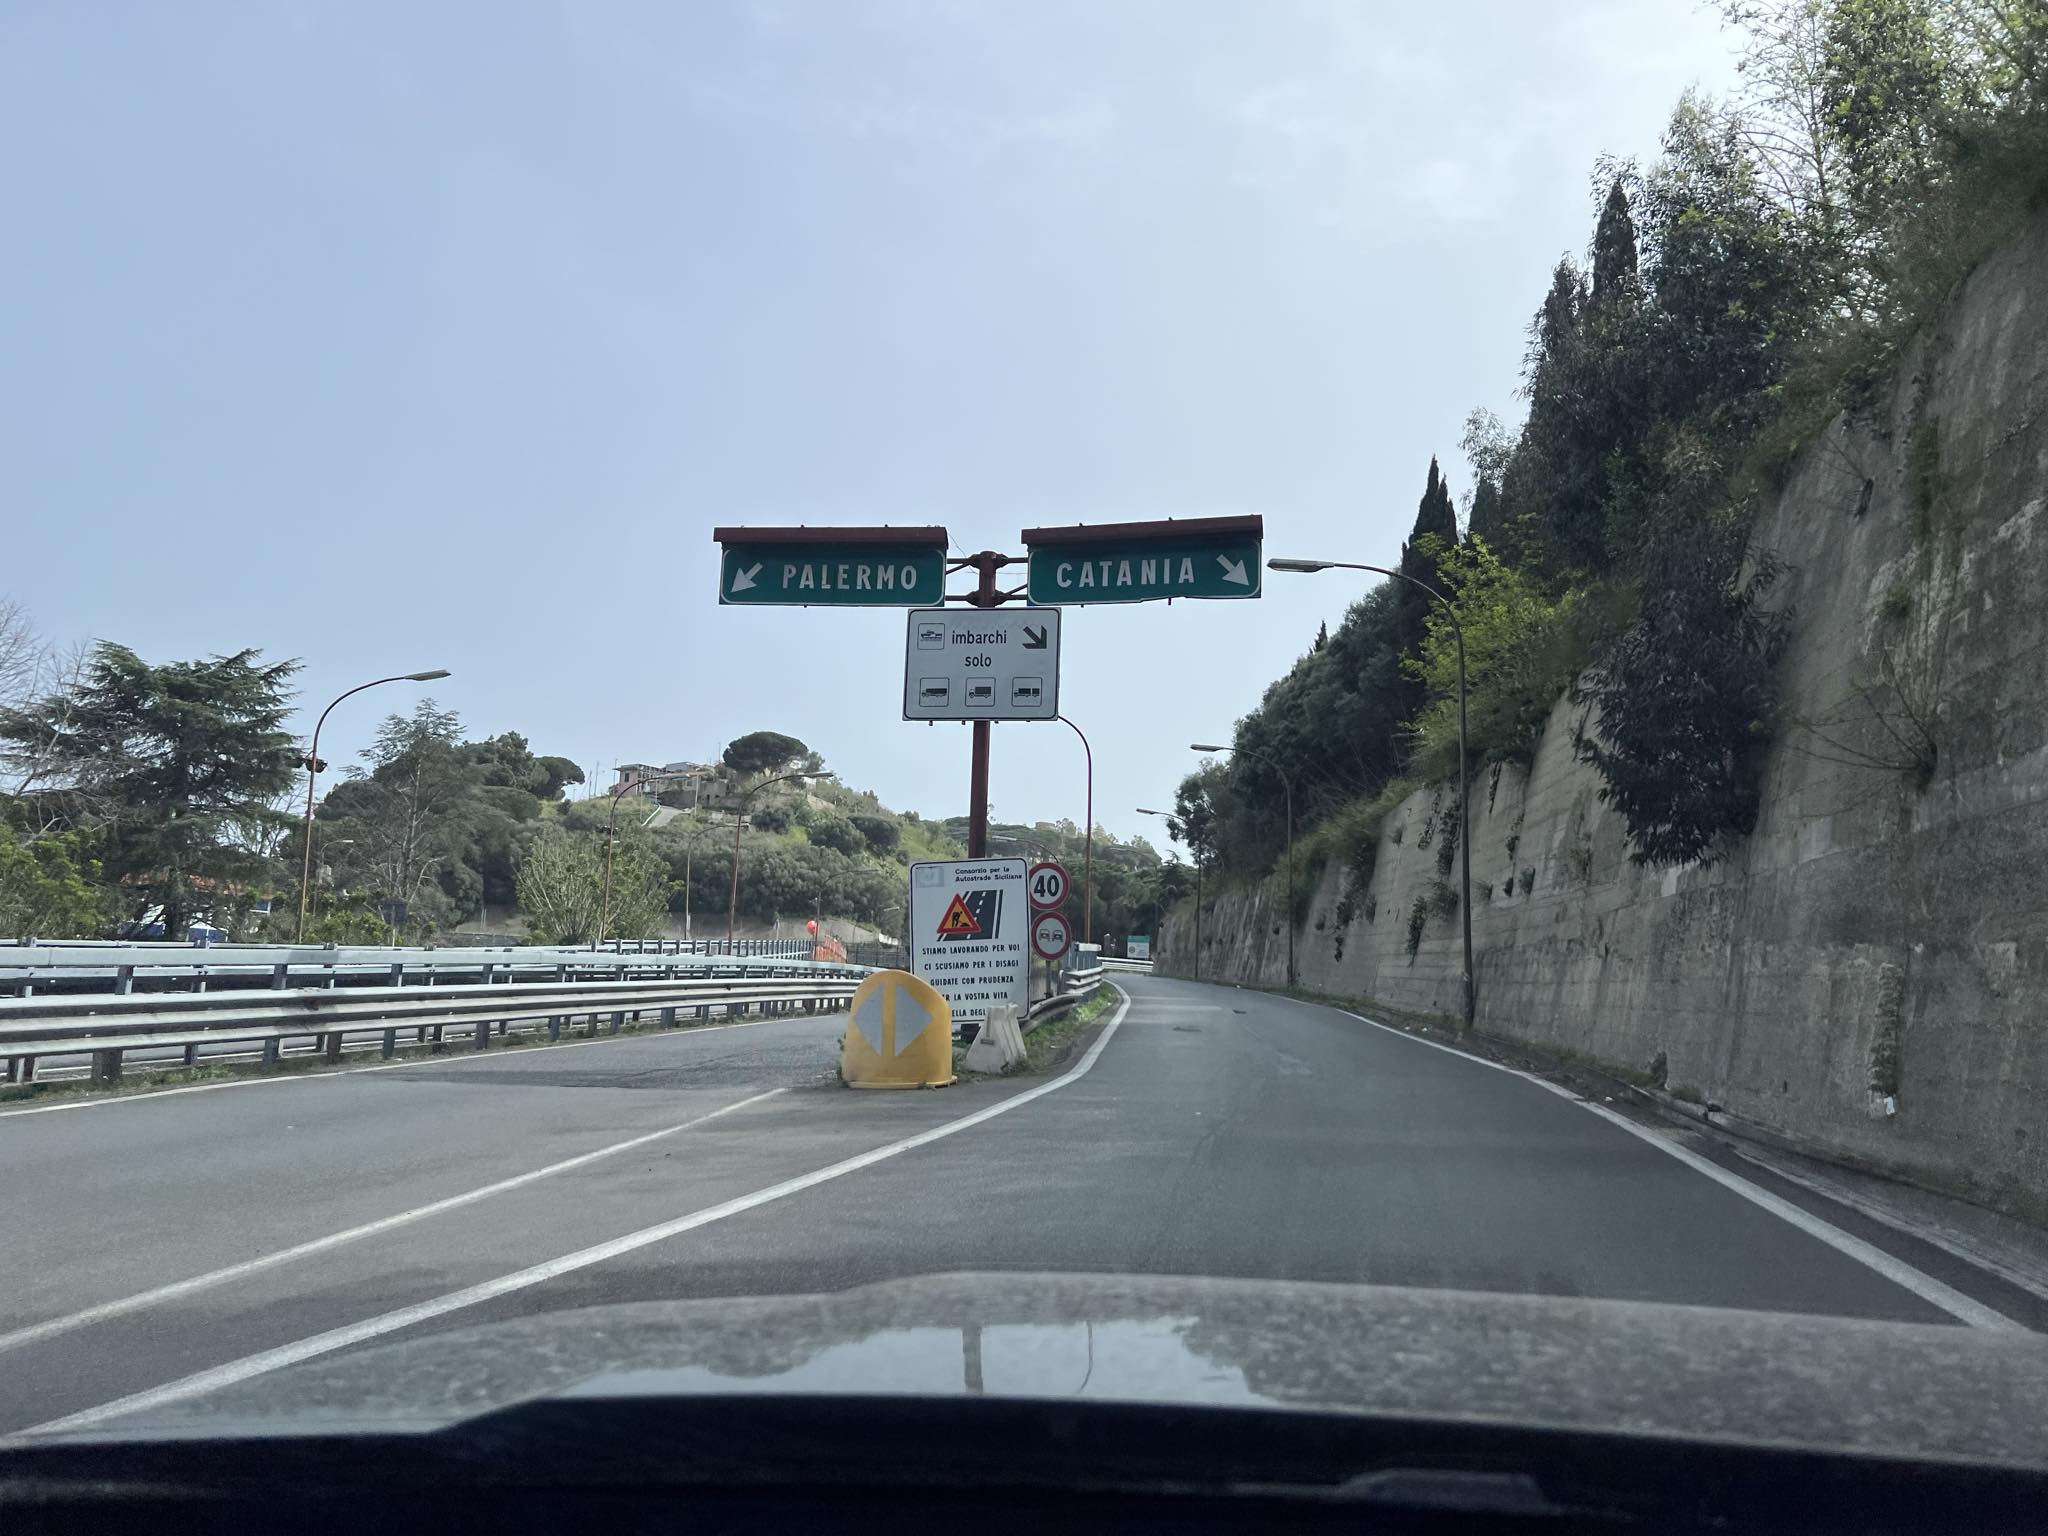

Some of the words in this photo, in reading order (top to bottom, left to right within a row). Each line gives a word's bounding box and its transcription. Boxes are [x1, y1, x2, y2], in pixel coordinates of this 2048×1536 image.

[782, 564, 918, 591] PALERMO
[1056, 556, 1195, 589] CATANIA
[951, 629, 1008, 645] imbarchi
[964, 652, 992, 667] solo
[1034, 875, 1060, 897] 40
[922, 947, 947, 955] STIAMO
[950, 946, 989, 954] LAVORANDO
[1008, 944, 1020, 952] VOI
[924, 962, 932, 970] CI
[935, 961, 969, 970] SCUSIAMO
[972, 960, 985, 968] PER
[930, 977, 958, 986] GUIDATE
[978, 976, 1014, 984] PRUDENZA
[964, 992, 990, 1000] VOSTRA
[952, 1009, 966, 1017] ELLA
[970, 1008, 986, 1016] DEGL
